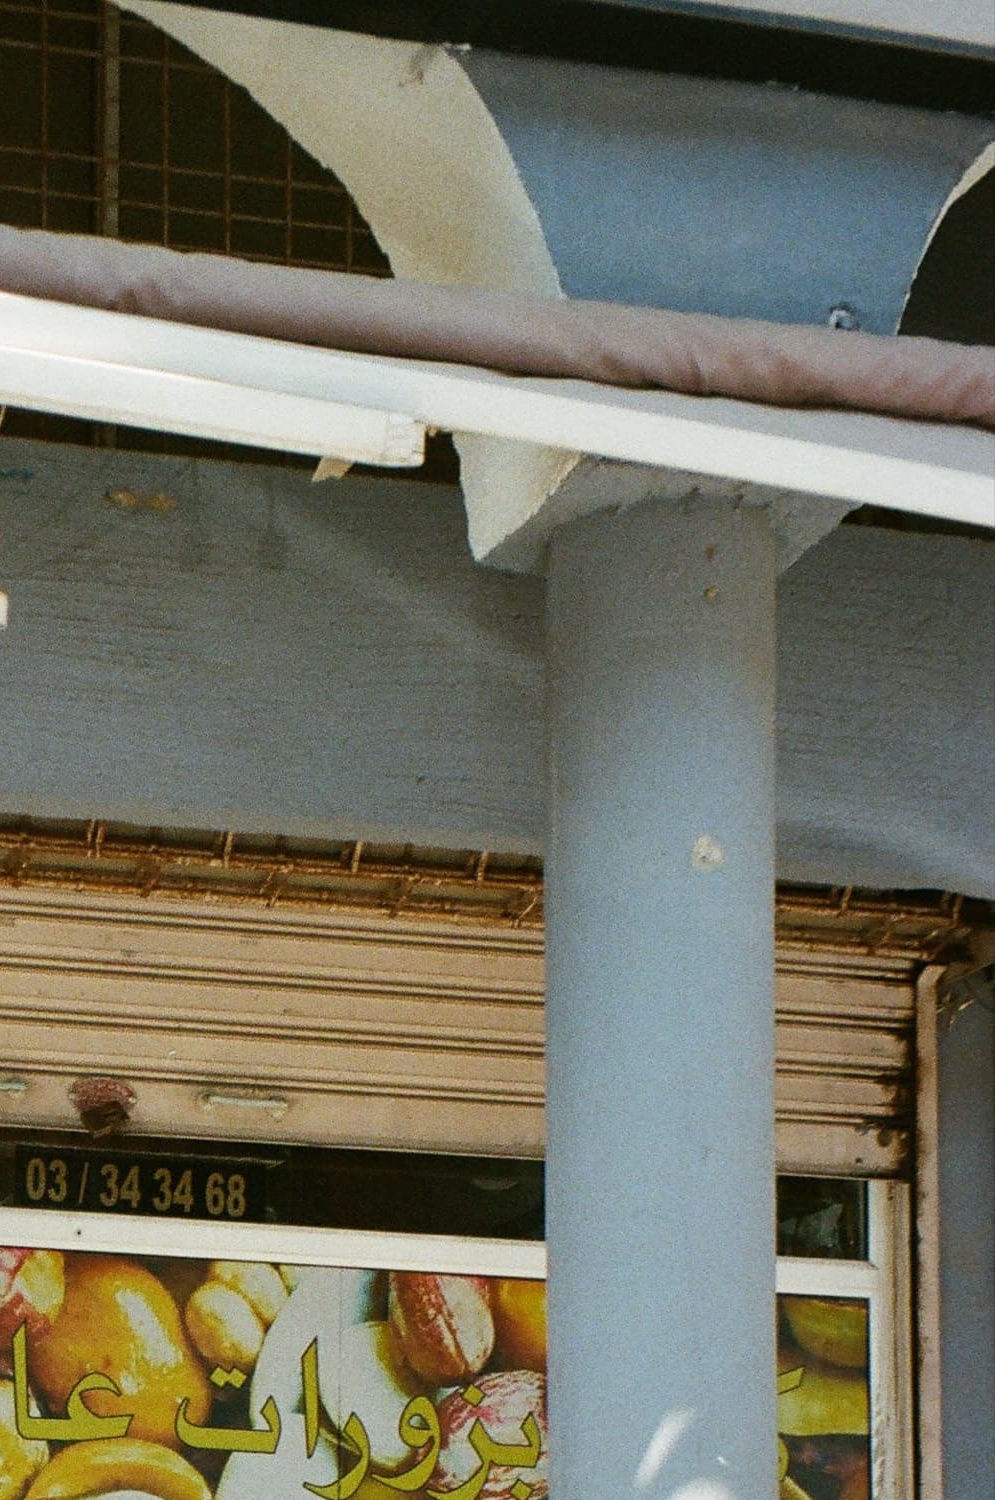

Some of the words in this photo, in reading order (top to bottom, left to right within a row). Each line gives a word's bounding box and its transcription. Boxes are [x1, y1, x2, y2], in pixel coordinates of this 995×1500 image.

[26, 1157, 68, 1203] 03
[100, 1163, 142, 1209] 34
[153, 1167, 194, 1213] 34
[206, 1172, 246, 1217] 68
